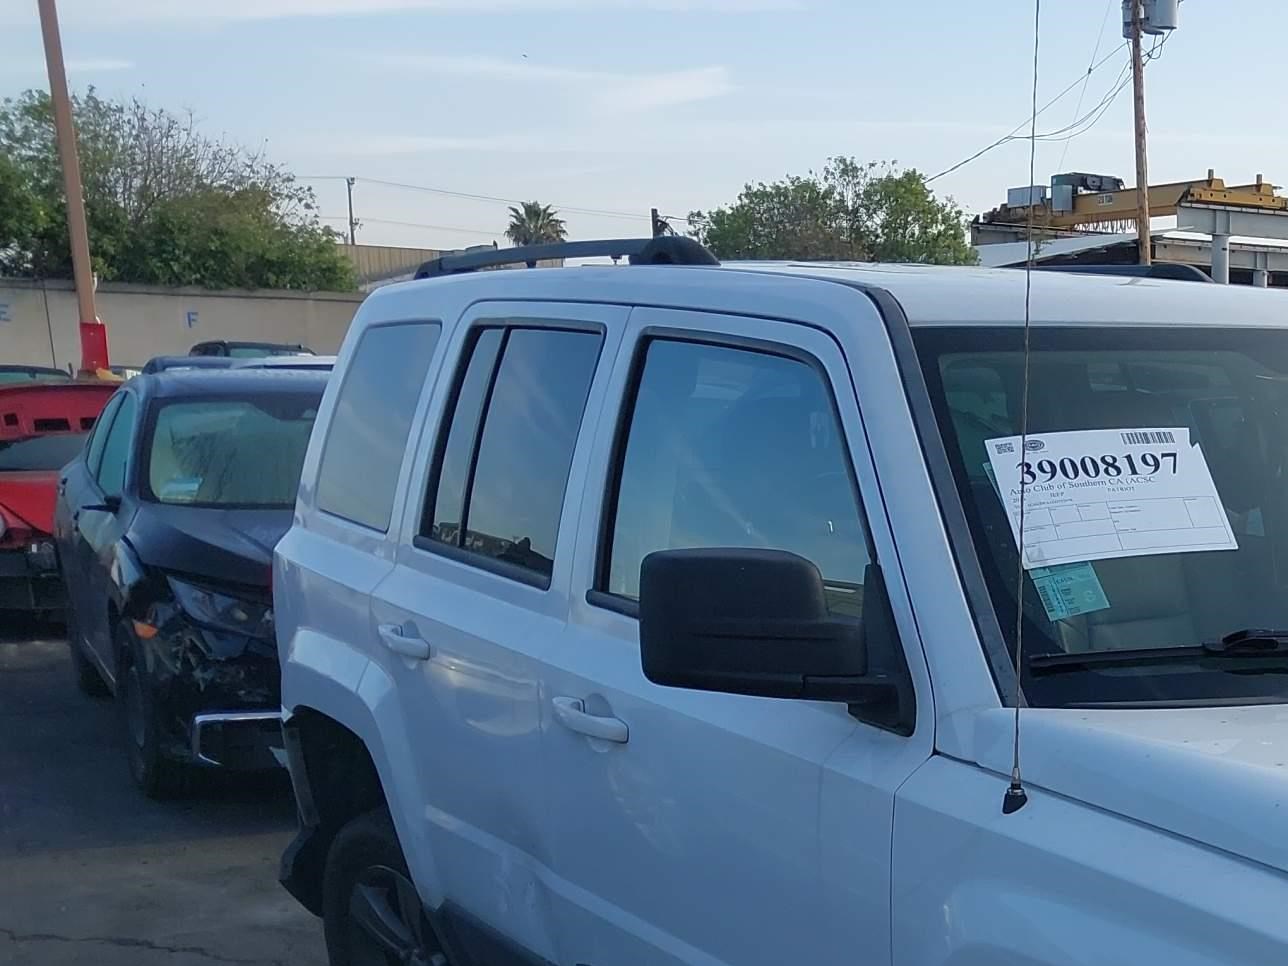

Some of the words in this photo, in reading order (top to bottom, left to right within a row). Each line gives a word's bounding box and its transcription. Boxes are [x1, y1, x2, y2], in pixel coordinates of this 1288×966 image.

[186, 311, 199, 329] F
[1016, 452, 1178, 486] 39008197
[1033, 482, 1055, 492] Club
[1056, 480, 1067, 489] of
[1068, 478, 1107, 489] Southern
[1108, 477, 1124, 486] CA
